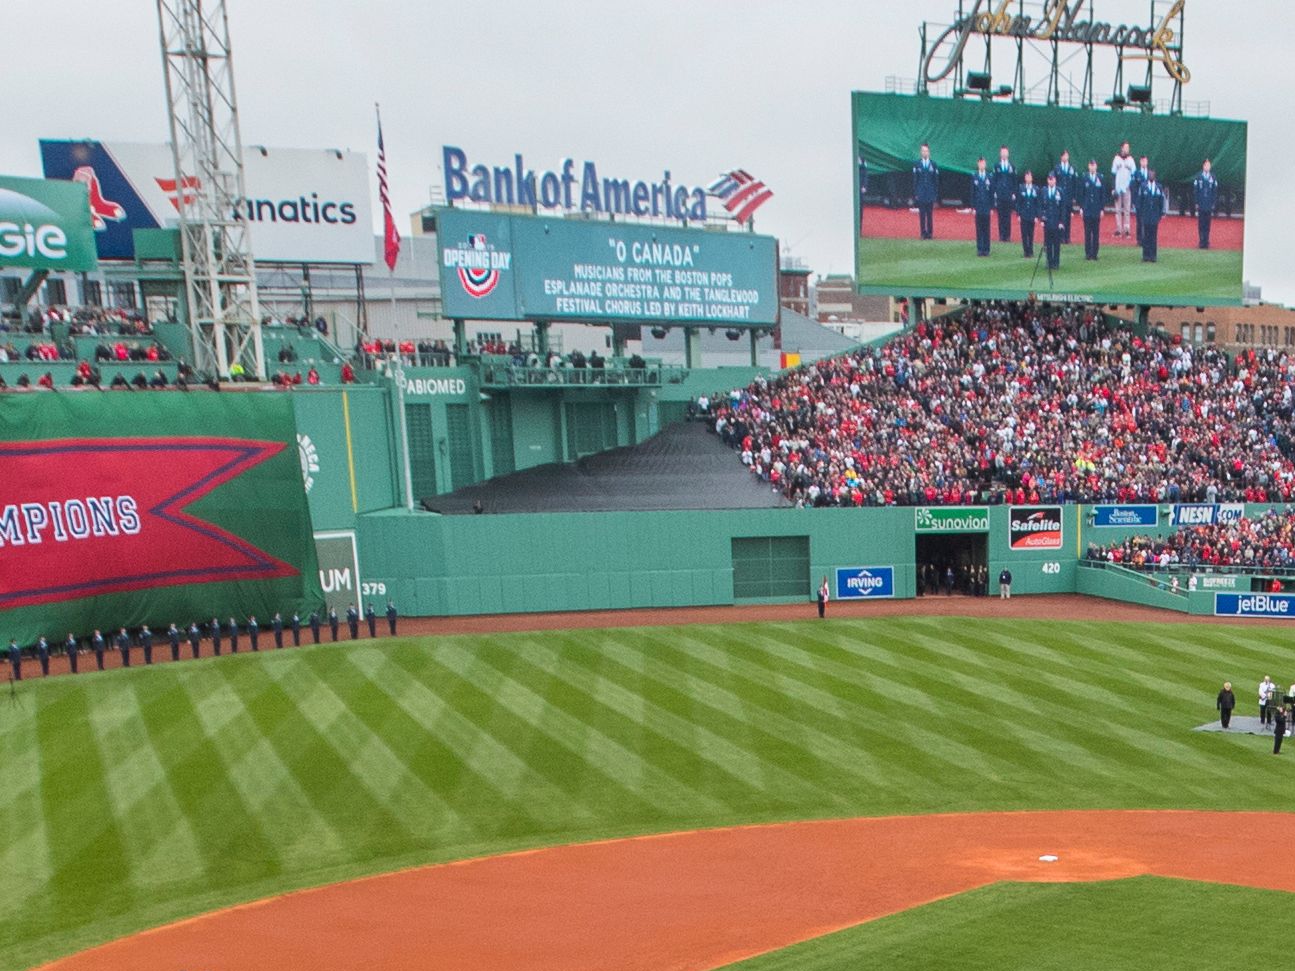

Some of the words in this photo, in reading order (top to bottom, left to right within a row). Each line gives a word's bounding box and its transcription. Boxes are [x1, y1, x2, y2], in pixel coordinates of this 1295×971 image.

[443, 145, 536, 206] Bank
[541, 158, 577, 209] of
[580, 160, 707, 221] America
[443, 249, 489, 269] OPENING
[491, 251, 512, 270] DAY
[574, 264, 624, 282] MUSICIANS
[627, 267, 653, 282] FROM
[655, 269, 673, 285] THE
[675, 270, 709, 286] BOSTON
[711, 272, 733, 287] POPS
[544, 279, 603, 297] ESPLANADE
[605, 283, 660, 299] ORCHESTRA
[663, 285, 682, 301] AND
[684, 287, 701, 301] THE
[704, 288, 759, 305] TANGLEWOOD
[556, 297, 603, 314] FESTIVAL
[605, 300, 642, 315] CHORUS
[644, 301, 661, 316] LED
[663, 302, 675, 317] BY
[678, 303, 704, 318] KEITH
[705, 305, 750, 319] LOCKHART
[406, 378, 466, 396] ABIOMED
[931, 515, 988, 529] sunovion
[1178, 506, 1214, 523] NESN
[1011, 519, 1061, 532] Safelite
[1025, 536, 1061, 546] AutoGlass
[1042, 562, 1061, 574] 420
[362, 582, 386, 596] 379
[847, 576, 883, 590] IRVING
[1237, 595, 1289, 614] jetBlue
